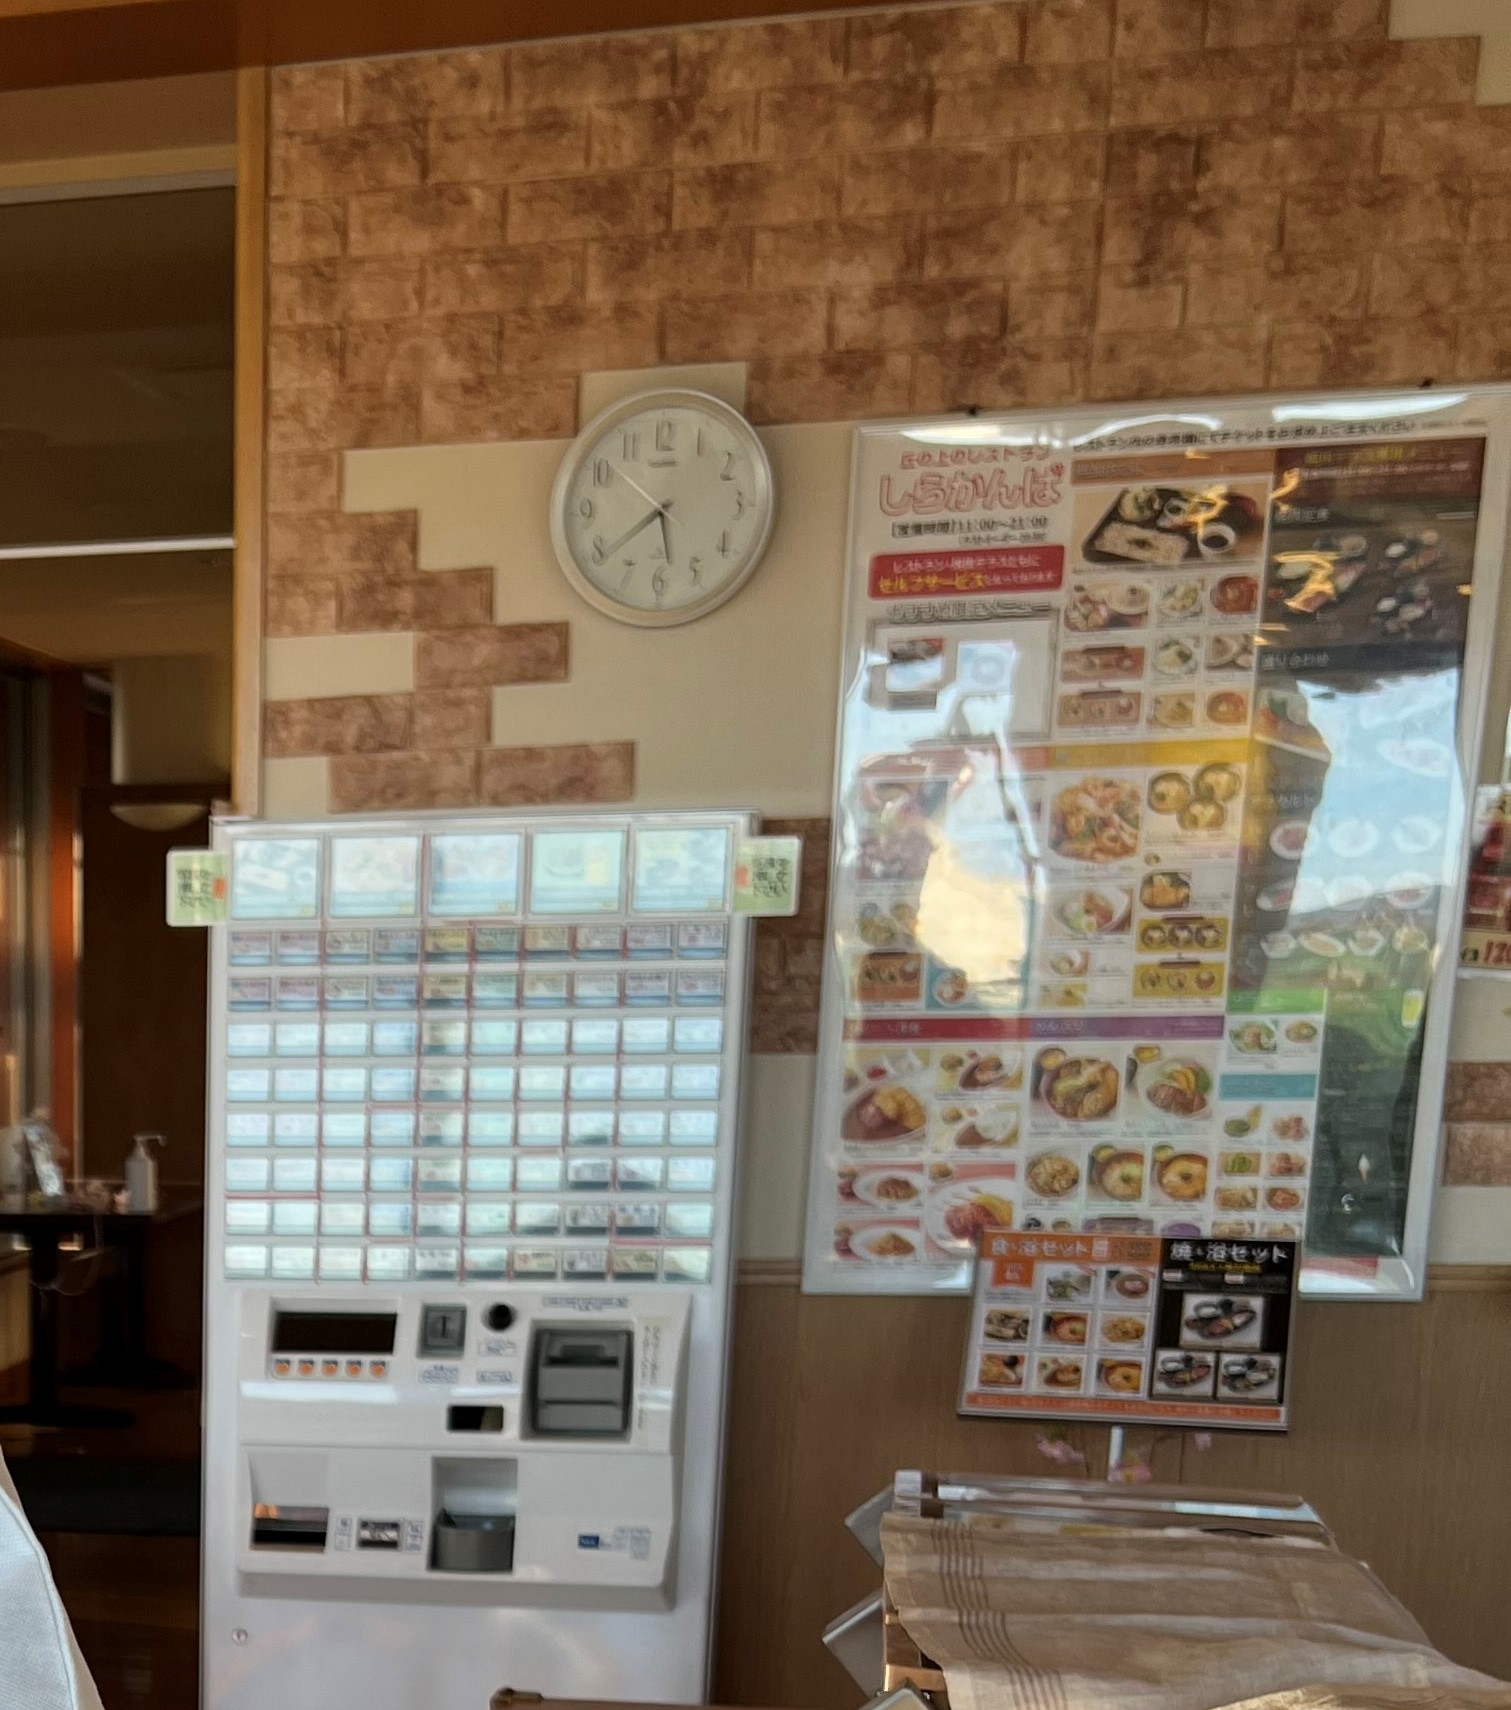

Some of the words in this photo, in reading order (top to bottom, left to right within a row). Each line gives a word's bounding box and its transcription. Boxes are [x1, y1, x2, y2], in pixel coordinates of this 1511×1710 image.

[623, 431, 640, 462] 11
[655, 420, 676, 452] 12
[697, 427, 703, 456] 1
[592, 459, 611, 488] 10
[720, 451, 734, 482] 2
[879, 461, 1065, 517] しらかんば
[580, 498, 595, 528] 9
[732, 489, 744, 521] 3
[591, 535, 608, 565] 8
[716, 528, 730, 558] 4
[621, 559, 637, 590] 7
[651, 563, 667, 595] 6
[689, 556, 702, 587] 5
